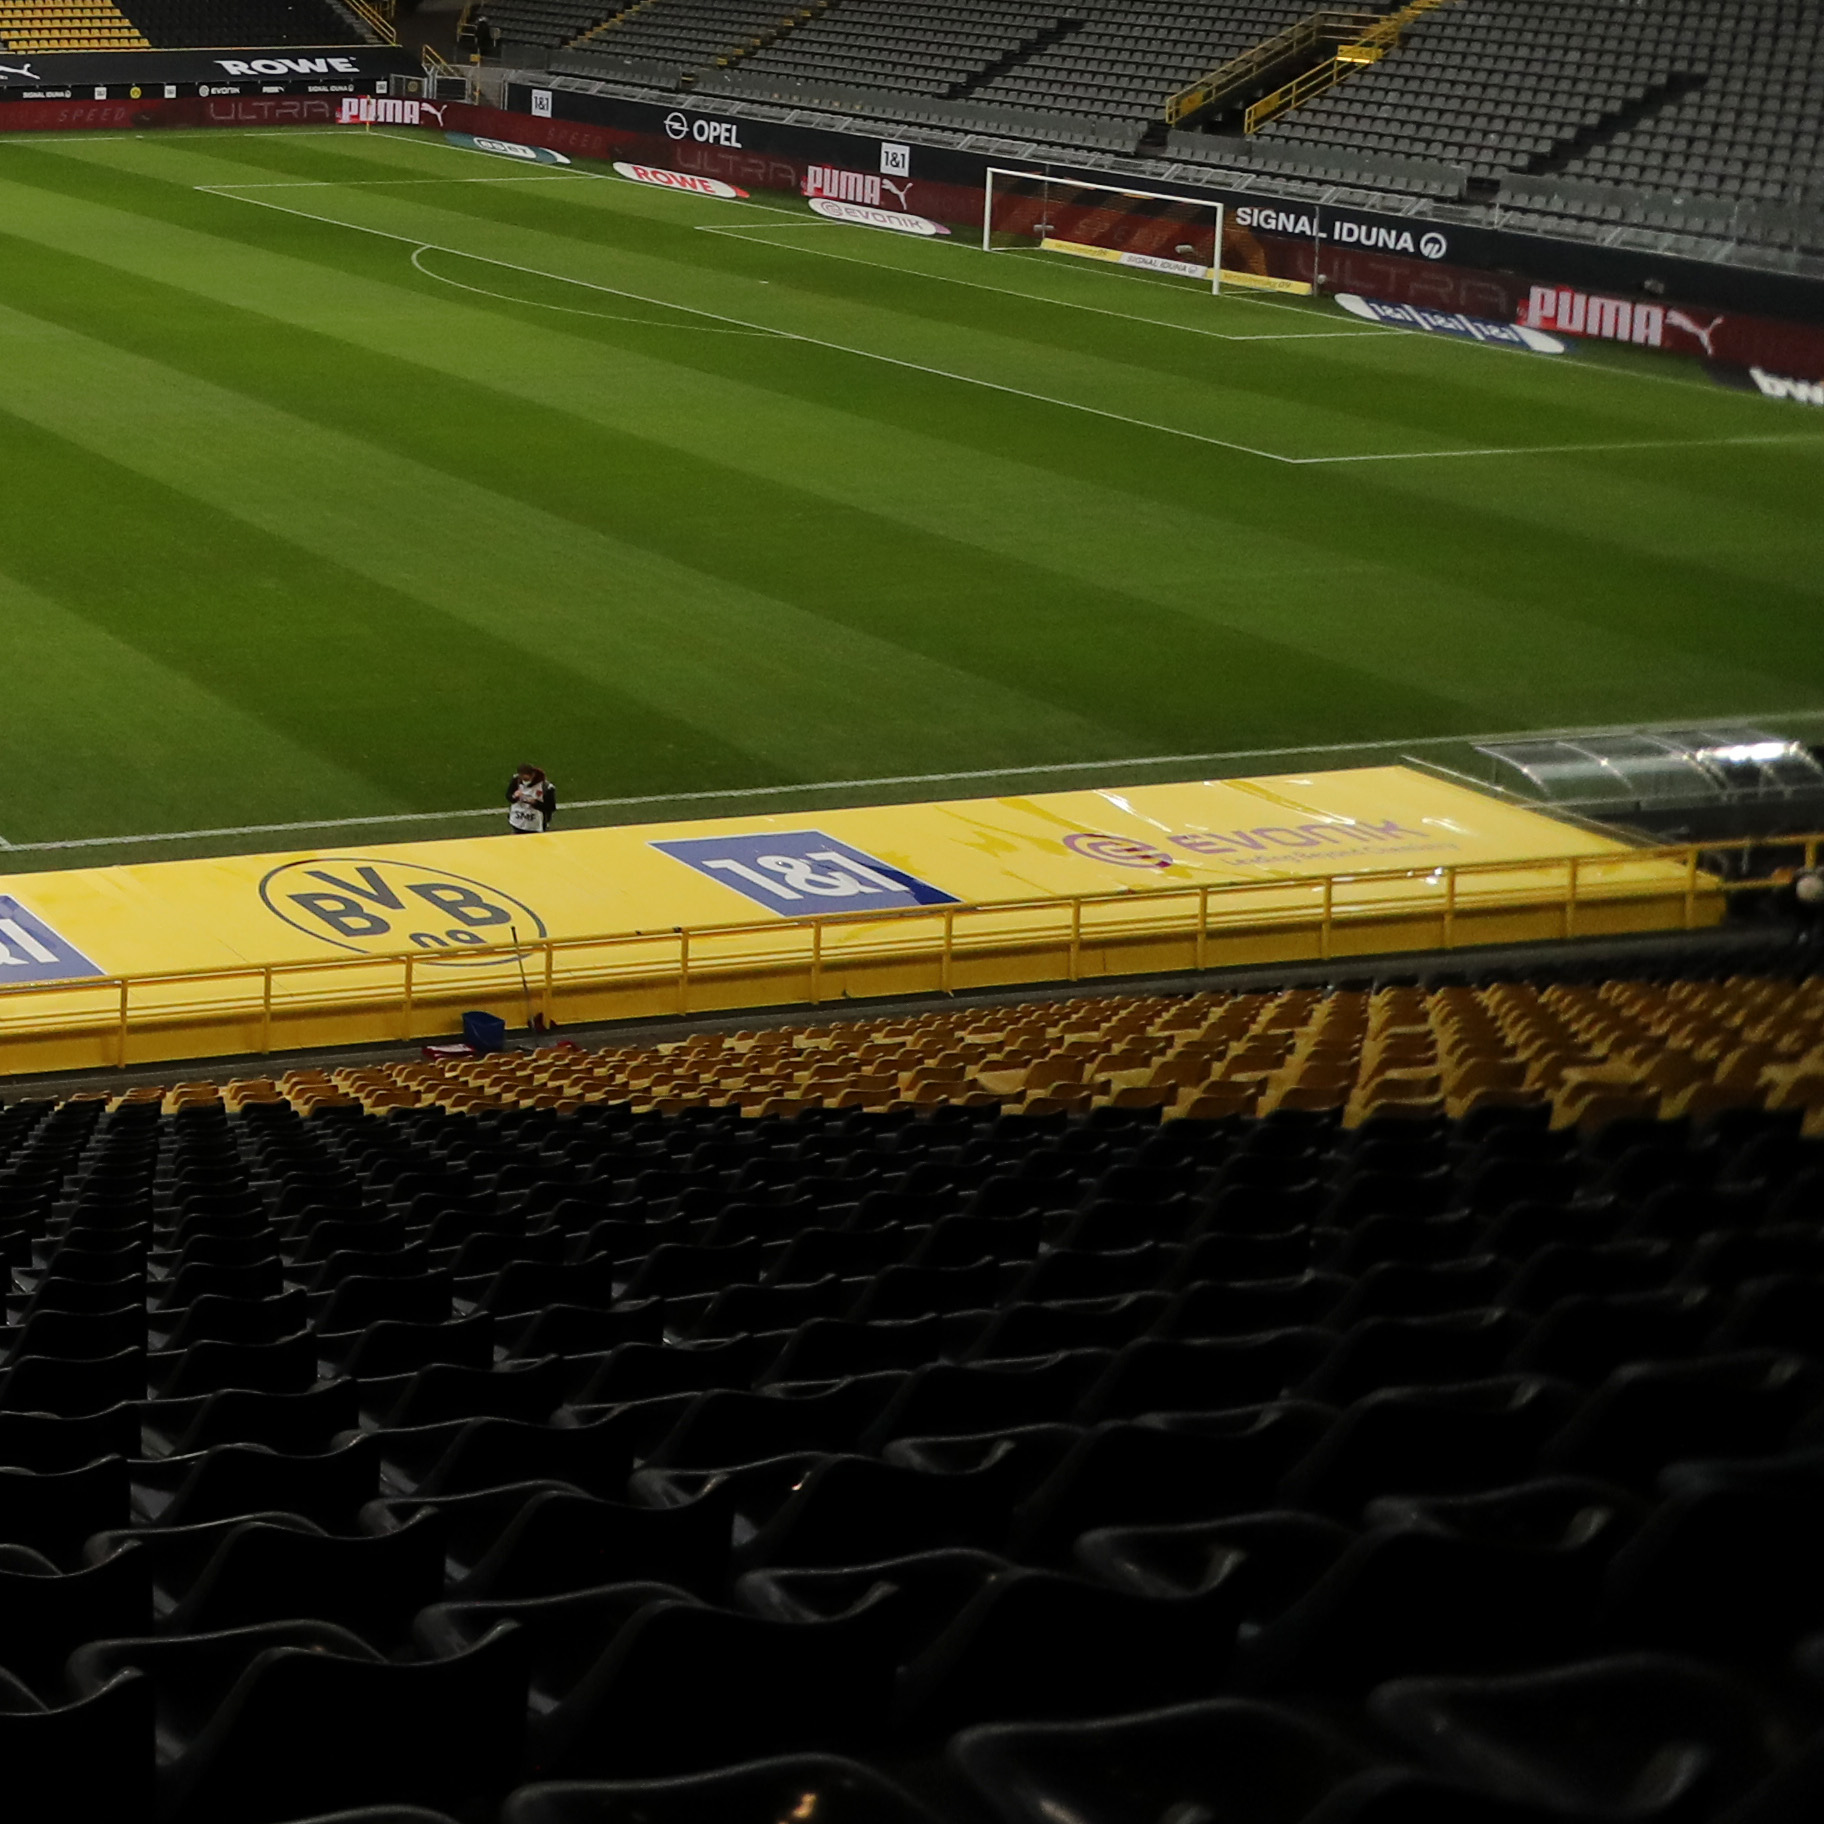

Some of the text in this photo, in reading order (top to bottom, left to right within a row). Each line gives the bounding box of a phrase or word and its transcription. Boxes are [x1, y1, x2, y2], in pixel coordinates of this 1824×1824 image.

[214, 57, 360, 75] ROWE
[209, 100, 331, 121] ULTRA
[341, 97, 421, 125] PUMA
[532, 94, 551, 114] 1&1
[692, 119, 743, 148] OPEL
[883, 150, 906, 169] 1&1
[632, 165, 716, 194] ROWE
[806, 165, 881, 206] PUMA
[839, 204, 923, 230] EVONIK
[1235, 206, 1415, 253] SIGNAL IDUNA
[1527, 286, 1665, 346] PUMA
[1167, 819, 1427, 855] EVONIK
[701, 850, 911, 900] 1&1
[286, 866, 512, 937] BVB
